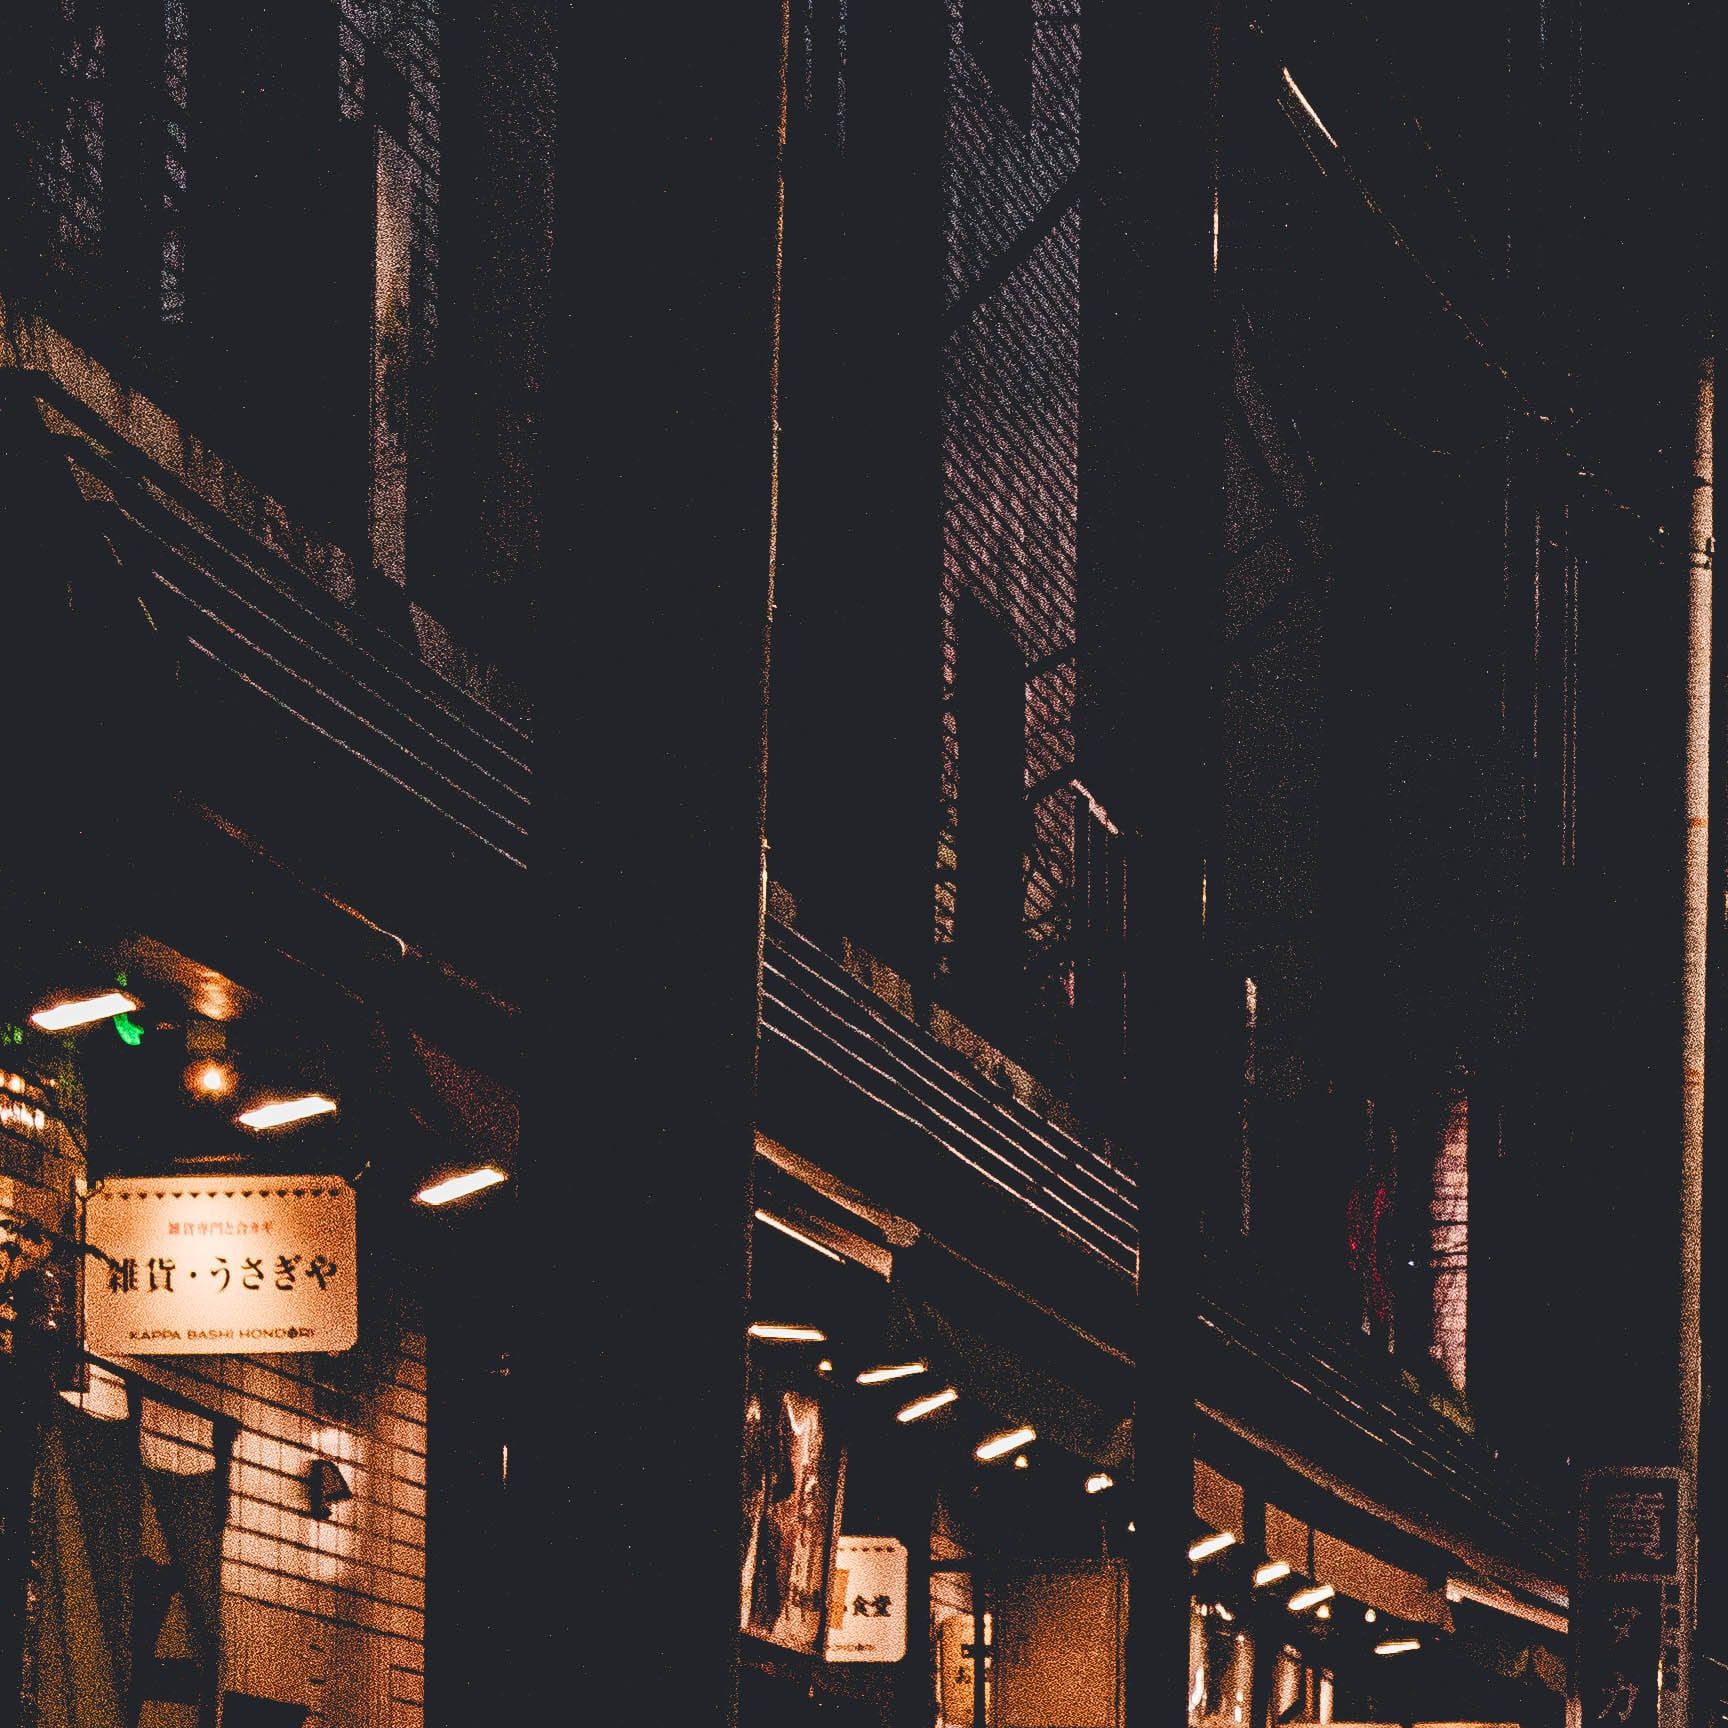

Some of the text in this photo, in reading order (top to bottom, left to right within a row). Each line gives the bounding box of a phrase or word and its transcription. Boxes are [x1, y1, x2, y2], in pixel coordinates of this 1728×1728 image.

[128, 1328, 182, 1341] KAPPA
[187, 1327, 234, 1341] BASHI
[843, 1594, 892, 1618] 食堂
